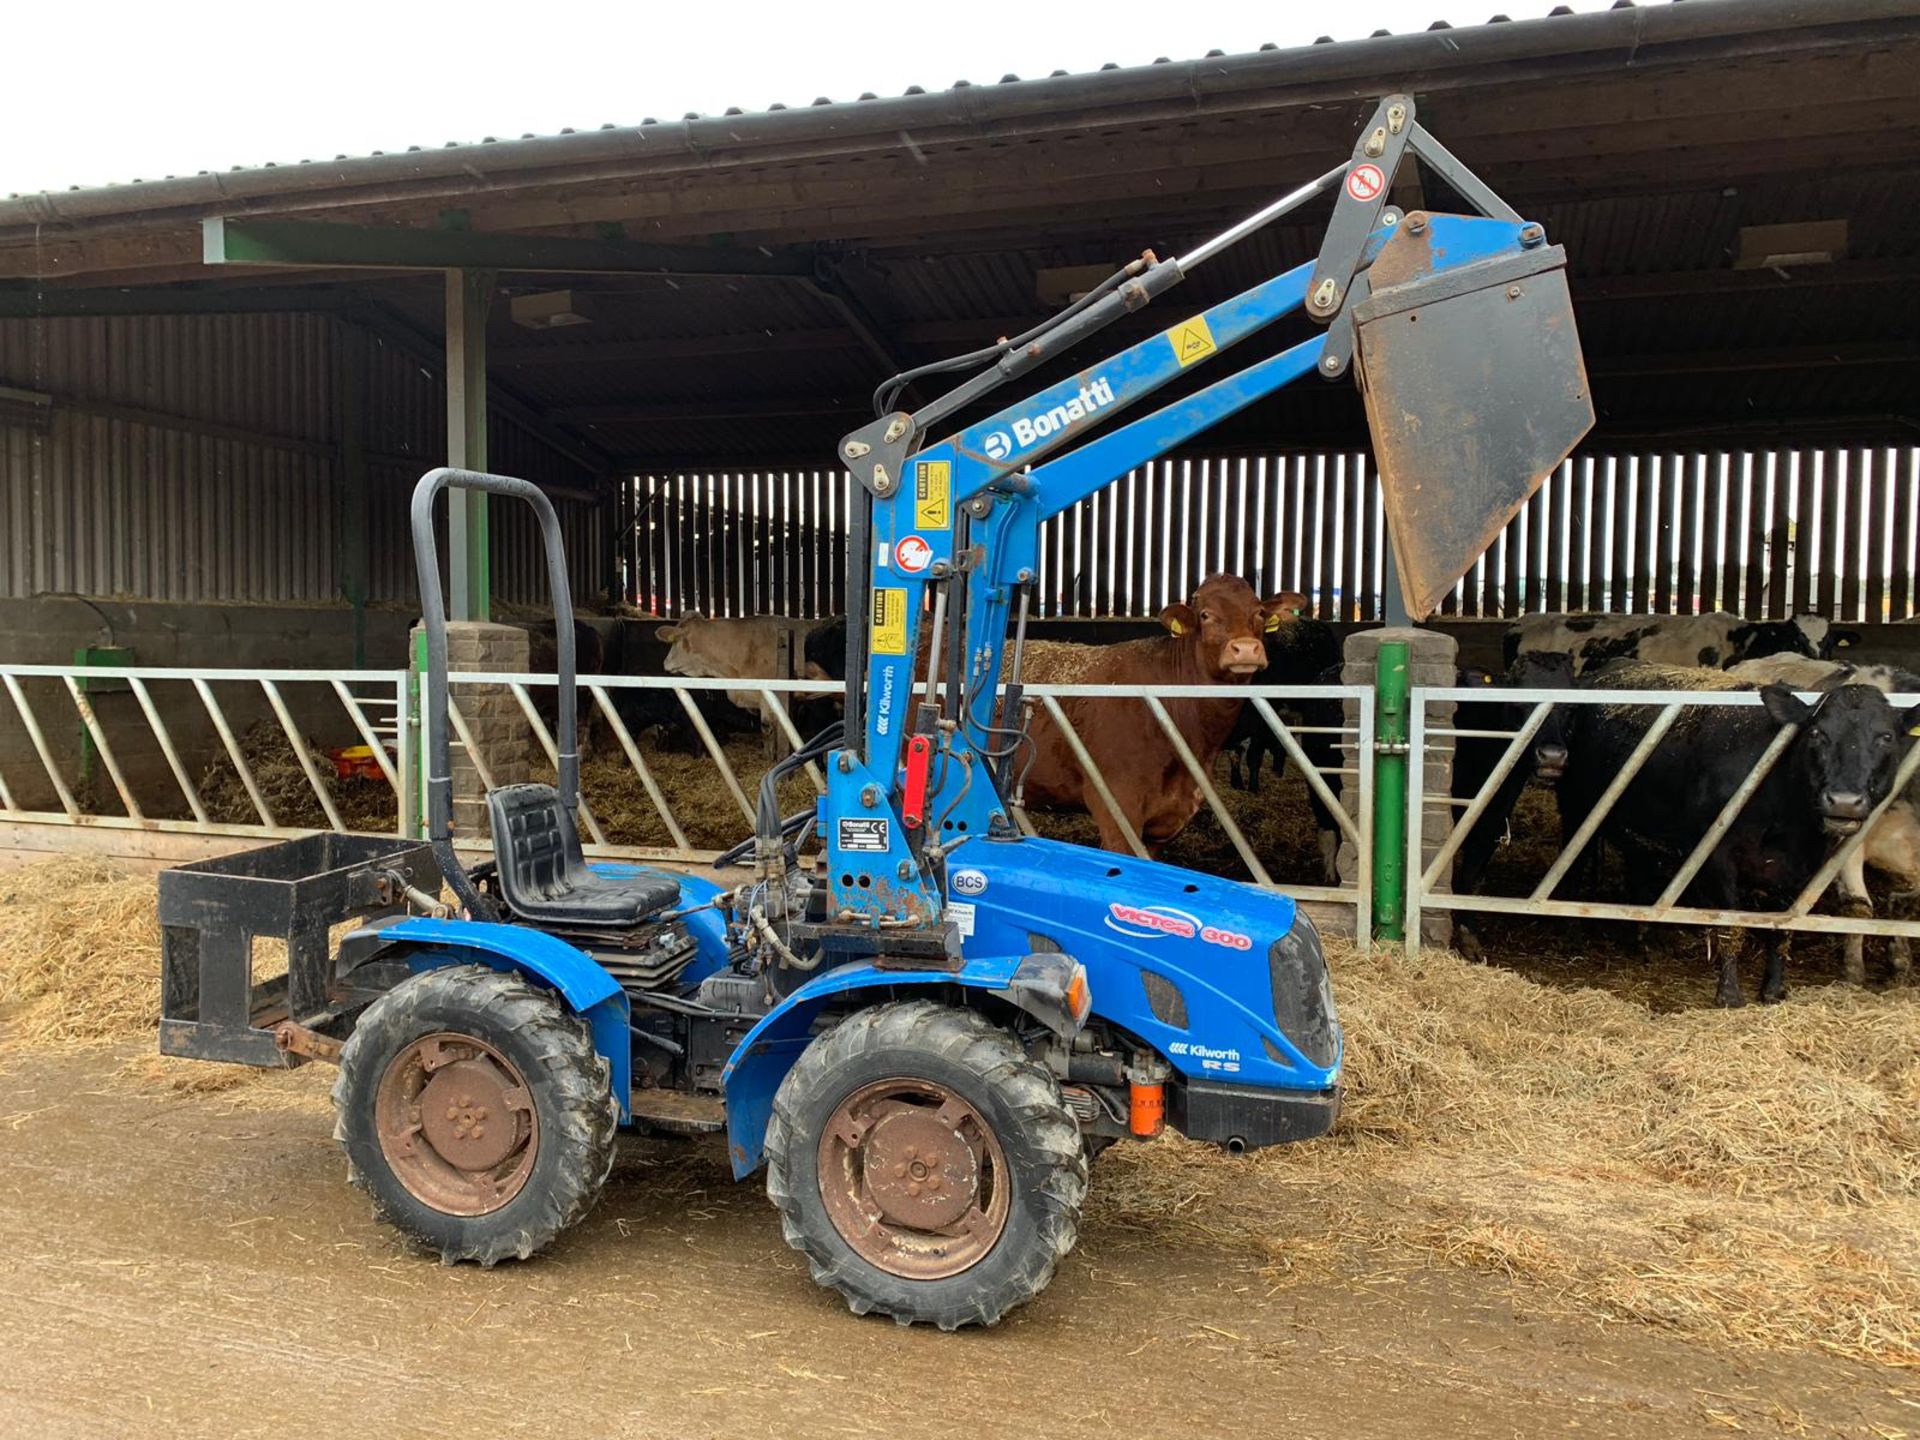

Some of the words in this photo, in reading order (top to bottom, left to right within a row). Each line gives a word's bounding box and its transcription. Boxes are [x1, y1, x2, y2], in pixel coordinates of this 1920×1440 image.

[1012, 377, 1116, 448] Bonatti
[918, 463, 927, 499] CAUTION
[875, 591, 884, 624] CAUTION
[879, 665, 894, 715] Kilworth
[956, 876, 983, 888] BCS
[1109, 903, 1195, 938] VICTOR
[1201, 926, 1252, 950] 300
[1190, 1044, 1240, 1061] Kilworth
[1202, 1060, 1240, 1072] RS
